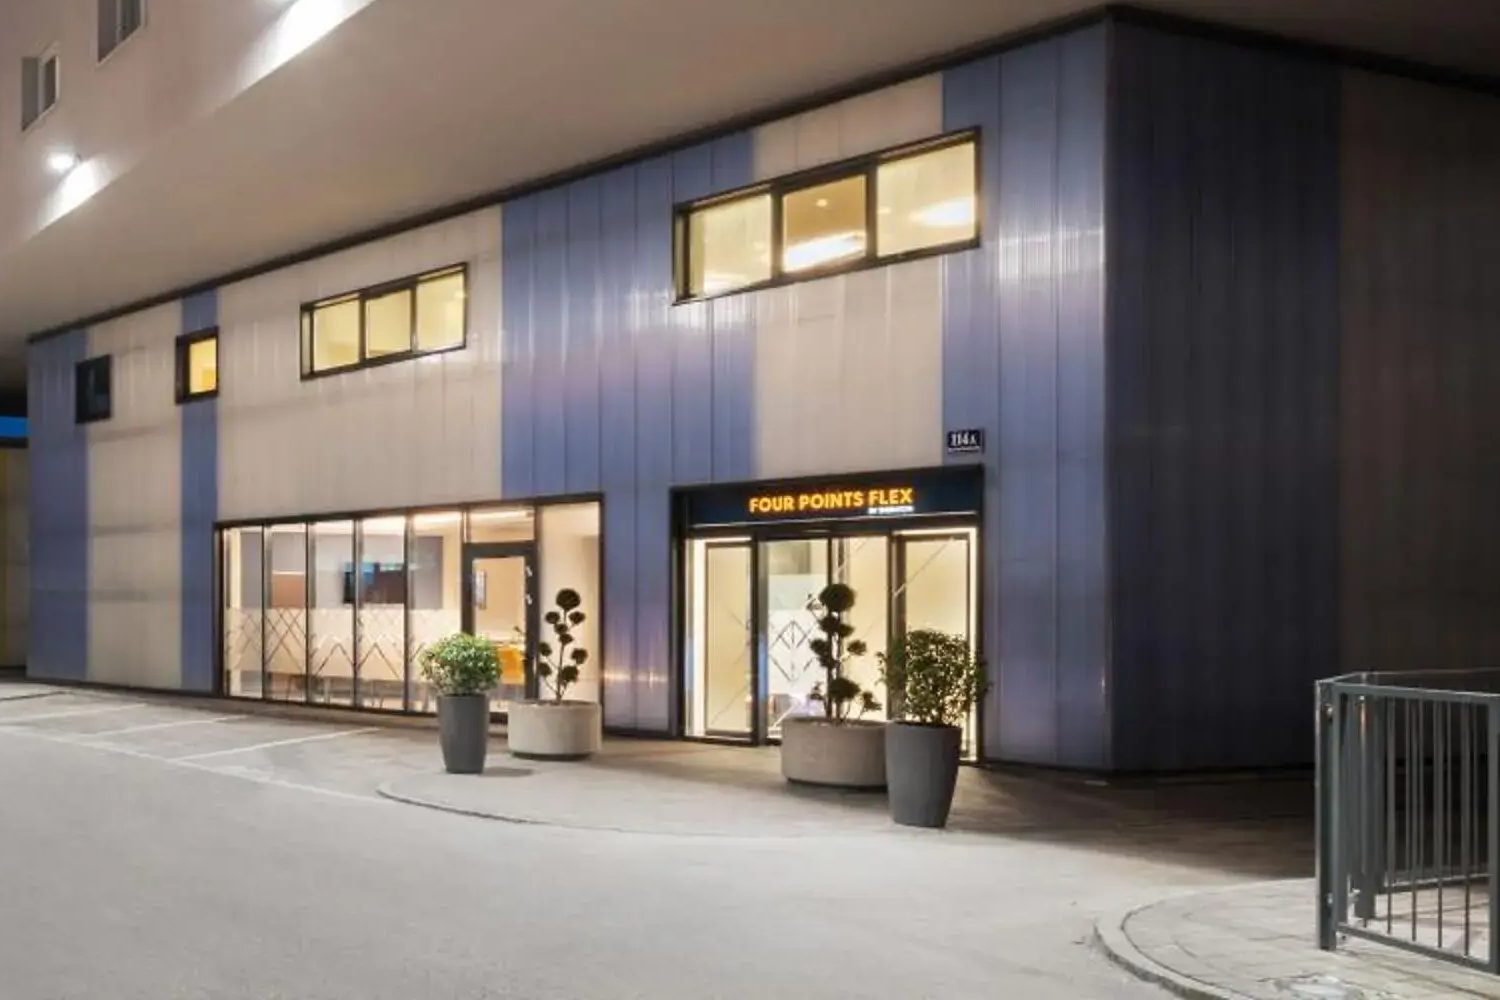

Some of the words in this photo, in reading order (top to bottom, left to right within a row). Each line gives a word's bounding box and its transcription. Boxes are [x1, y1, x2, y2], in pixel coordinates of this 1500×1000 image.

[749, 496, 795, 513] FOUR
[798, 490, 865, 510] POINTS
[868, 488, 913, 506] FLEX
